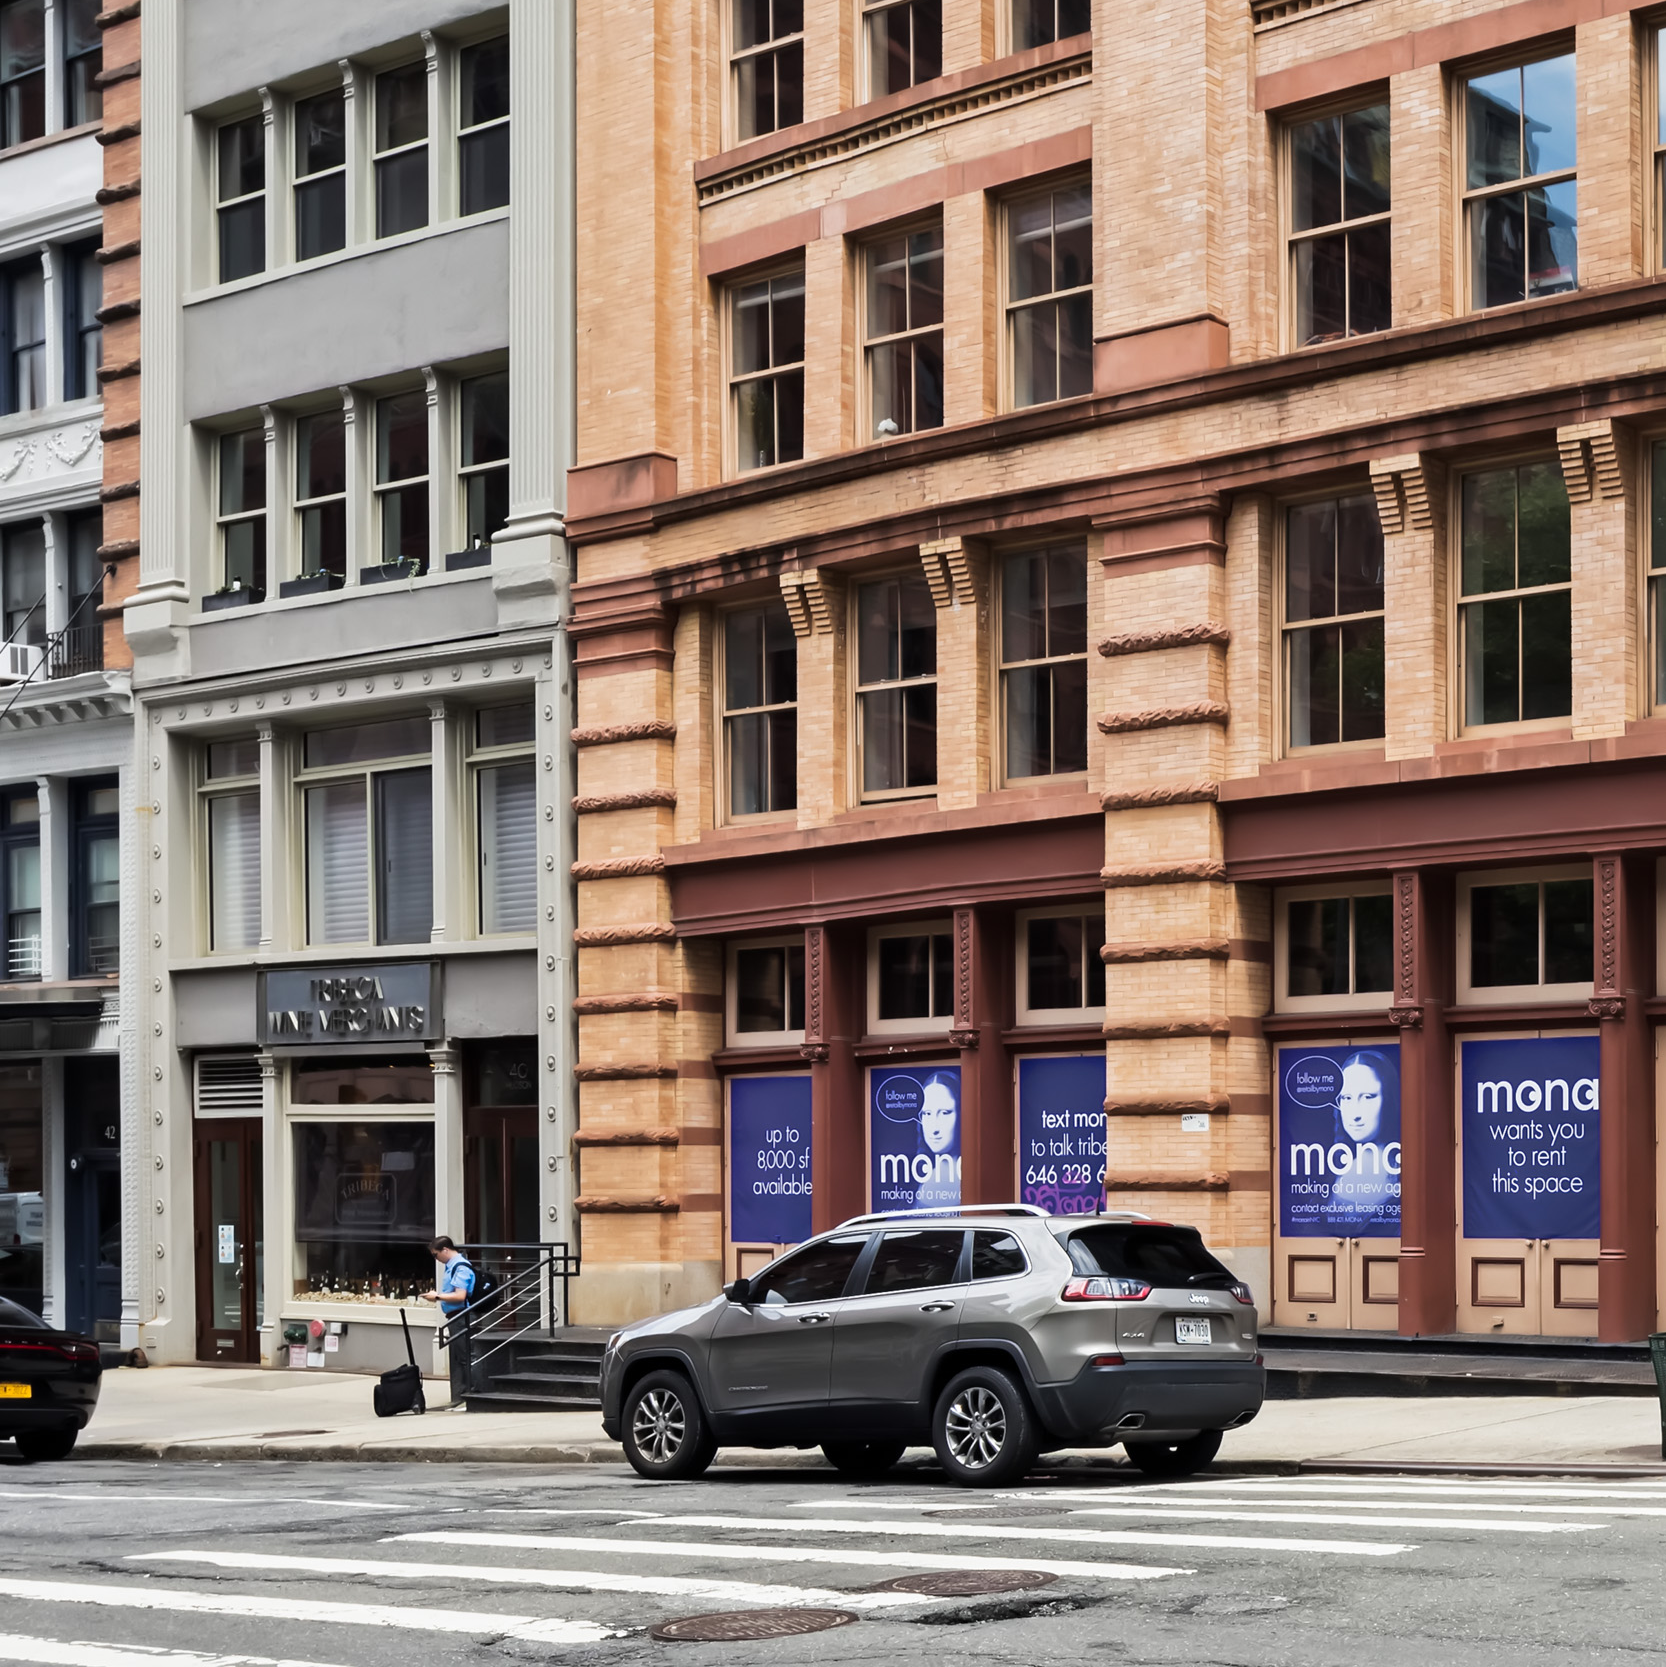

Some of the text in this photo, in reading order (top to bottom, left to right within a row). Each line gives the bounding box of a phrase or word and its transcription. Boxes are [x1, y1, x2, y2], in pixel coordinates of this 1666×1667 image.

[310, 976, 384, 1002] TRIBECA
[268, 1006, 425, 1035] WINE MERCHANTS
[1296, 1072, 1334, 1084] follow me
[886, 1090, 917, 1100] follow me
[1477, 1078, 1599, 1113] mona
[1042, 1110, 1070, 1128] text
[104, 1125, 116, 1139] 42
[766, 1126, 800, 1148] up to
[1489, 1120, 1585, 1146] wants you
[1031, 1139, 1046, 1156] to
[1049, 1133, 1074, 1156] talk
[757, 1147, 810, 1171] 8,000 sf
[1508, 1145, 1567, 1167] to rent
[880, 1153, 961, 1183] mon
[1026, 1164, 1057, 1184] 646
[1062, 1164, 1091, 1184] 328
[753, 1173, 813, 1195] available
[880, 1185, 914, 1204] making
[916, 1183, 925, 1200] of
[926, 1190, 934, 1200] a
[935, 1190, 957, 1200] new
[1291, 1178, 1329, 1198] making
[1331, 1177, 1344, 1194] of
[1345, 1183, 1354, 1194] a
[1357, 1182, 1382, 1194] new
[1492, 1167, 1583, 1200] this space
[1291, 1204, 1319, 1213] contact
[1320, 1201, 1354, 1213] exclusive
[1355, 1201, 1384, 1216] leasing
[1189, 1293, 1209, 1305] Jeep
